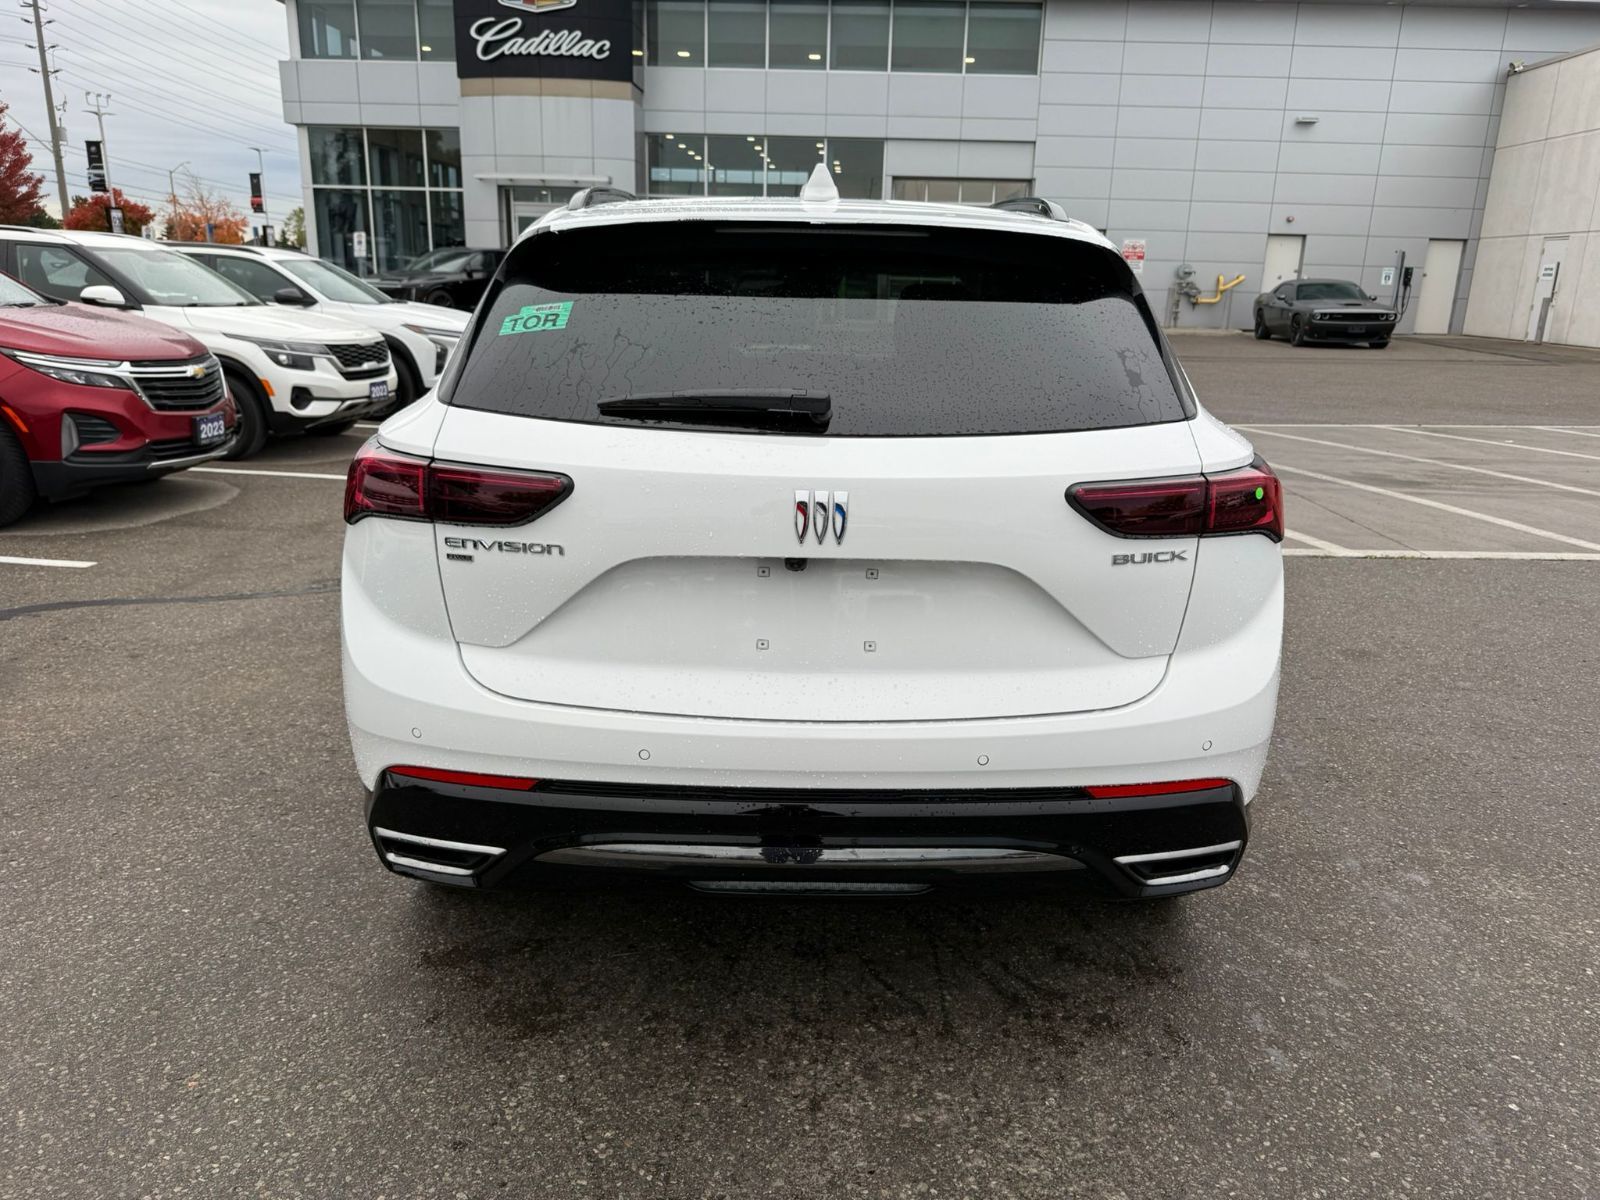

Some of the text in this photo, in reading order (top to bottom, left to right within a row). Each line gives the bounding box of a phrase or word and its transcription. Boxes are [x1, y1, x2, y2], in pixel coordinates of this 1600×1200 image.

[470, 17, 611, 61] Cadillac
[509, 312, 560, 332] TOR
[371, 384, 388, 398] 2023
[200, 420, 225, 439] 2023
[444, 536, 565, 556] ENVISION
[1111, 549, 1189, 566] BUICK
